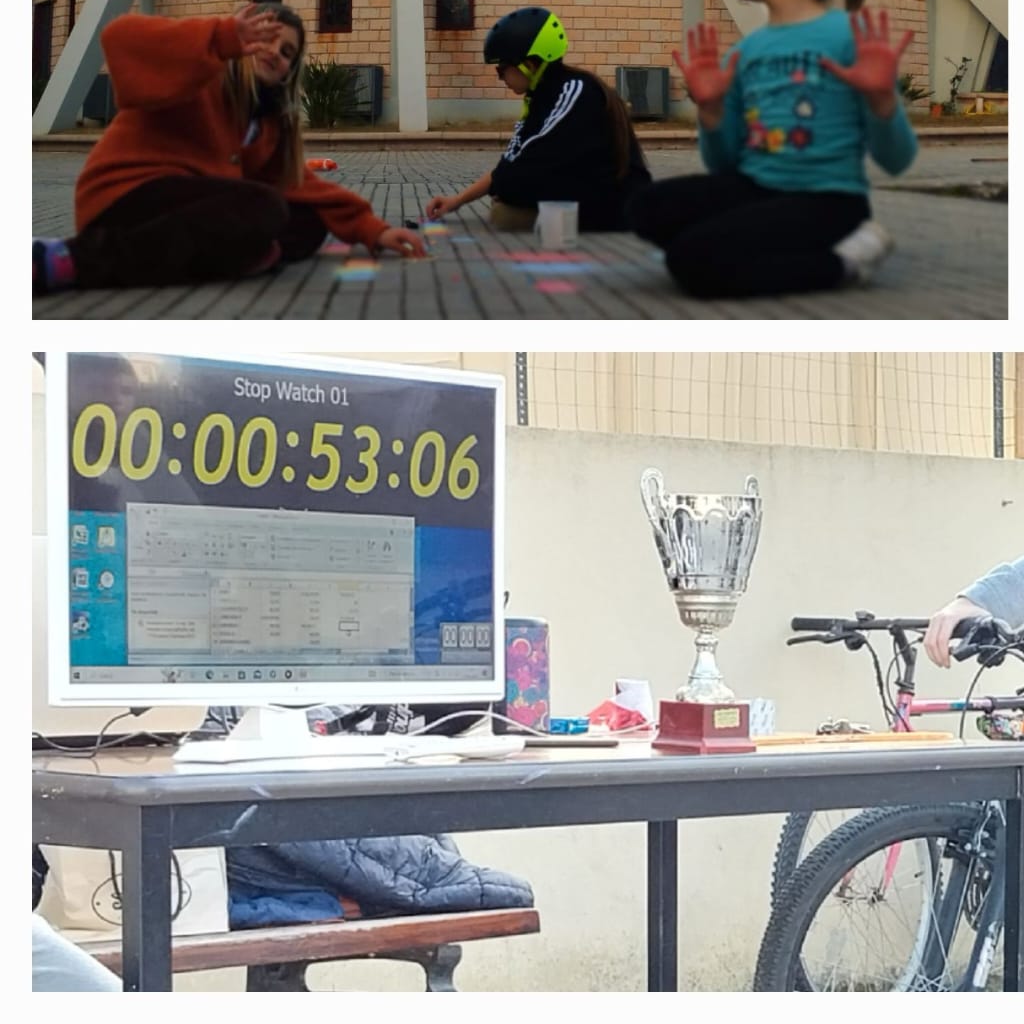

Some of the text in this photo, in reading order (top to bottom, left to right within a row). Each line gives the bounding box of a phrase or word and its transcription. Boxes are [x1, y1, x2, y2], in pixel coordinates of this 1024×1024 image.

[233, 376, 349, 407] Stop Watch 01
[72, 403, 480, 501] 00:00:53:06
